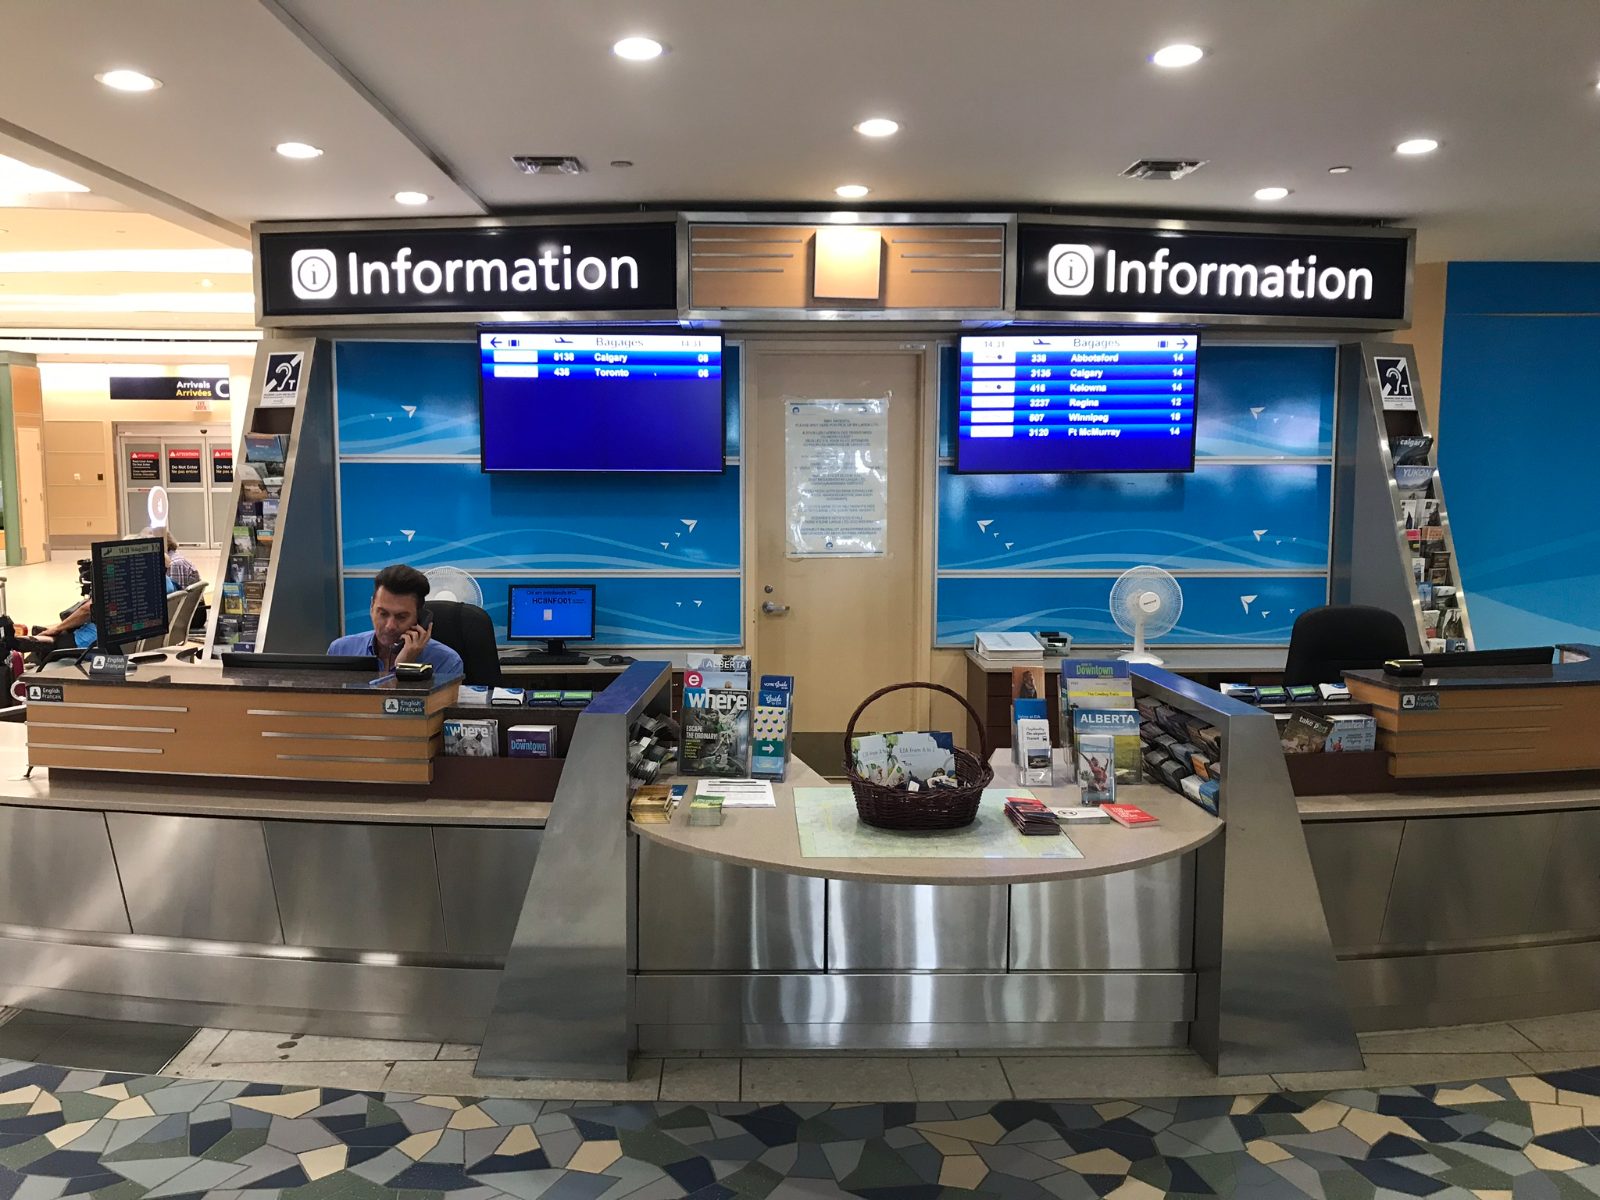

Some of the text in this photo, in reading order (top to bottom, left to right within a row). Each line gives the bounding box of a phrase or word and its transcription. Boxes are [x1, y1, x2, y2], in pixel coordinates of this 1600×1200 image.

[349, 245, 638, 295] Information
[1106, 248, 1373, 300] Information
[594, 352, 628, 364] Calgary
[1071, 353, 1119, 363] Abbotsford
[1173, 353, 1184, 362] 14
[594, 367, 630, 378] Toronto
[1070, 368, 1104, 379] Calgary
[1172, 368, 1183, 377] 14
[176, 381, 211, 389] Arrivals
[215, 379, 229, 398] C
[1069, 383, 1107, 393] Kelowna
[1171, 383, 1183, 392] 14
[175, 389, 212, 397] Arrivées
[1069, 398, 1099, 409] Regina
[1170, 397, 1182, 407] 12
[1068, 413, 1109, 424] Winnipeg
[1068, 427, 1078, 437] Ft
[1078, 427, 1121, 438] McMurray
[1169, 426, 1180, 436] 14
[1400, 439, 1426, 448] calgary
[1402, 469, 1432, 478] YUKON
[705, 660, 747, 669] ALBERTA
[1076, 664, 1114, 676] Downtown
[688, 674, 700, 686] e
[687, 688, 748, 710] where
[1080, 713, 1136, 724] ALBERTA
[1299, 716, 1313, 727] take
[450, 723, 489, 737] where
[511, 740, 547, 751] Downtown
